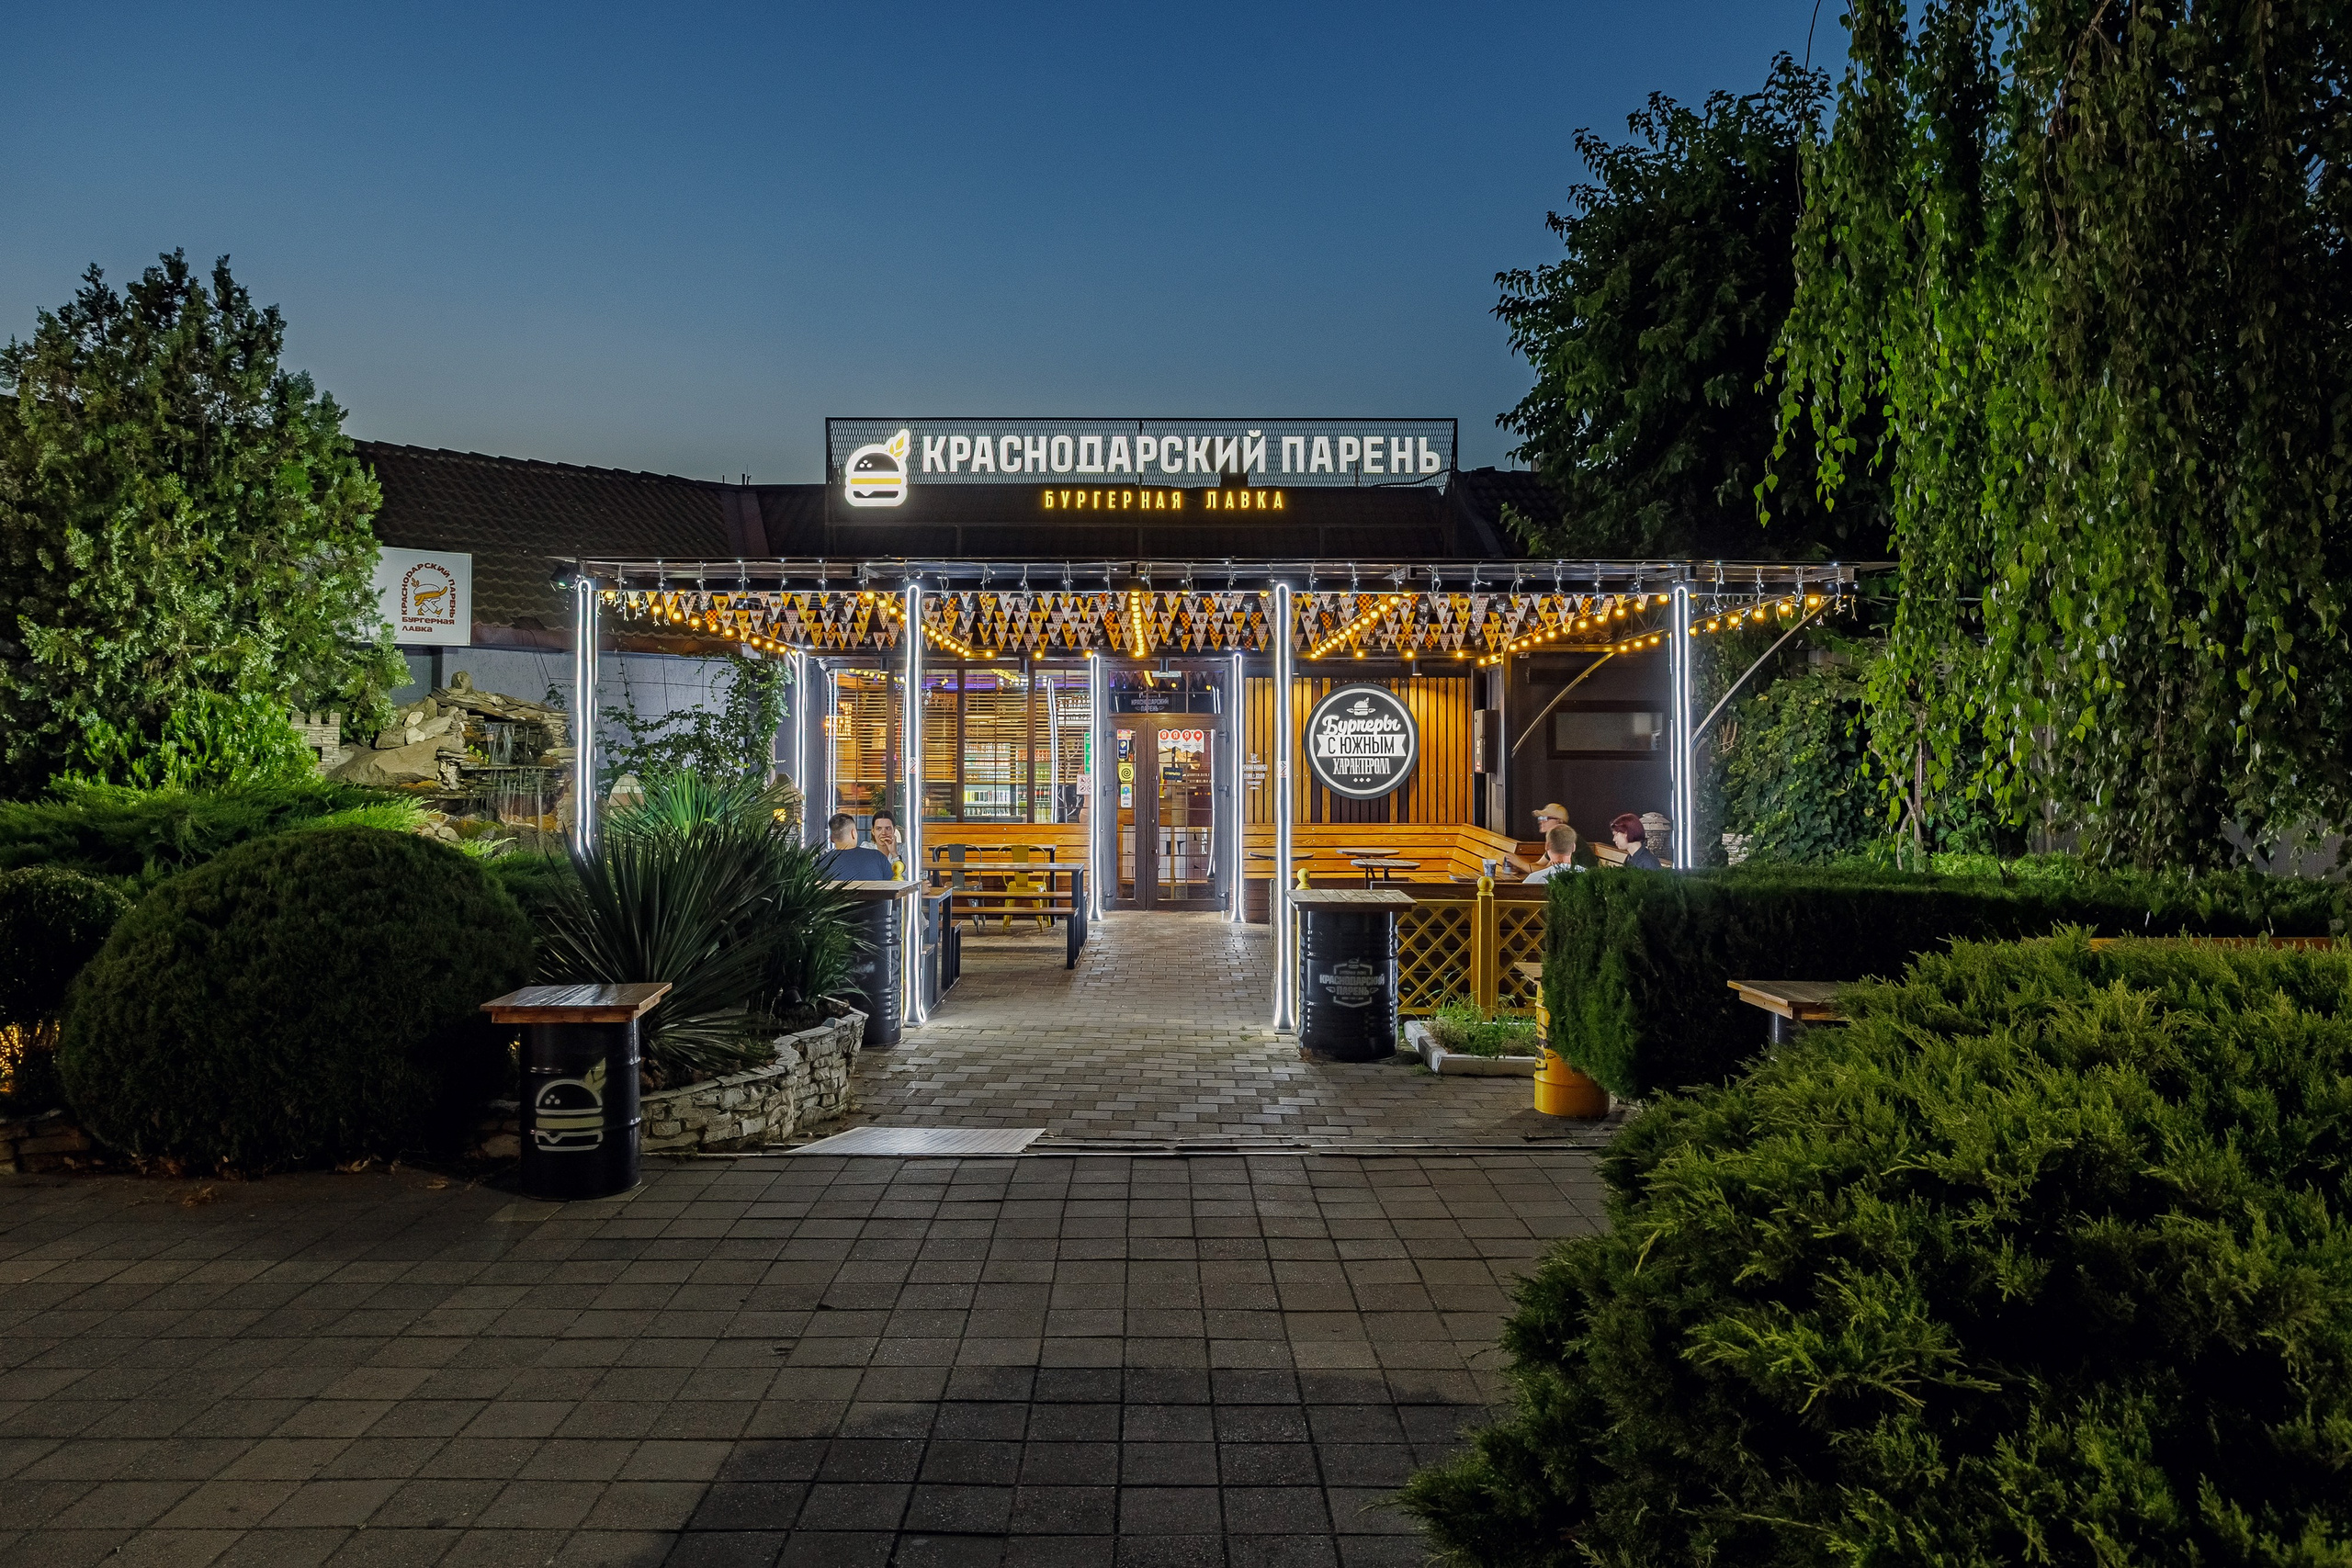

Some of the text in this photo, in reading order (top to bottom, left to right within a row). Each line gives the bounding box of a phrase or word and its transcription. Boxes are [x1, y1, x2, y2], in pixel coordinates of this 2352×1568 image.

[922, 429, 1441, 474] КРАСНОДАРСКИЙ ПАРЕНЬ
[1045, 490, 1284, 510] БУРГЕРНАЯ ЛАВКА
[401, 562, 457, 618] КРАСНОДАРСКИЙ ПАРЕНЬ
[1322, 714, 1401, 737] Бургеры
[1328, 737, 1395, 754] С ЮЖНЫМ
[1332, 758, 1391, 774] ХАРАКТЕРОМ
[1319, 974, 1385, 986] КРАСНОДАРСКИЙ
